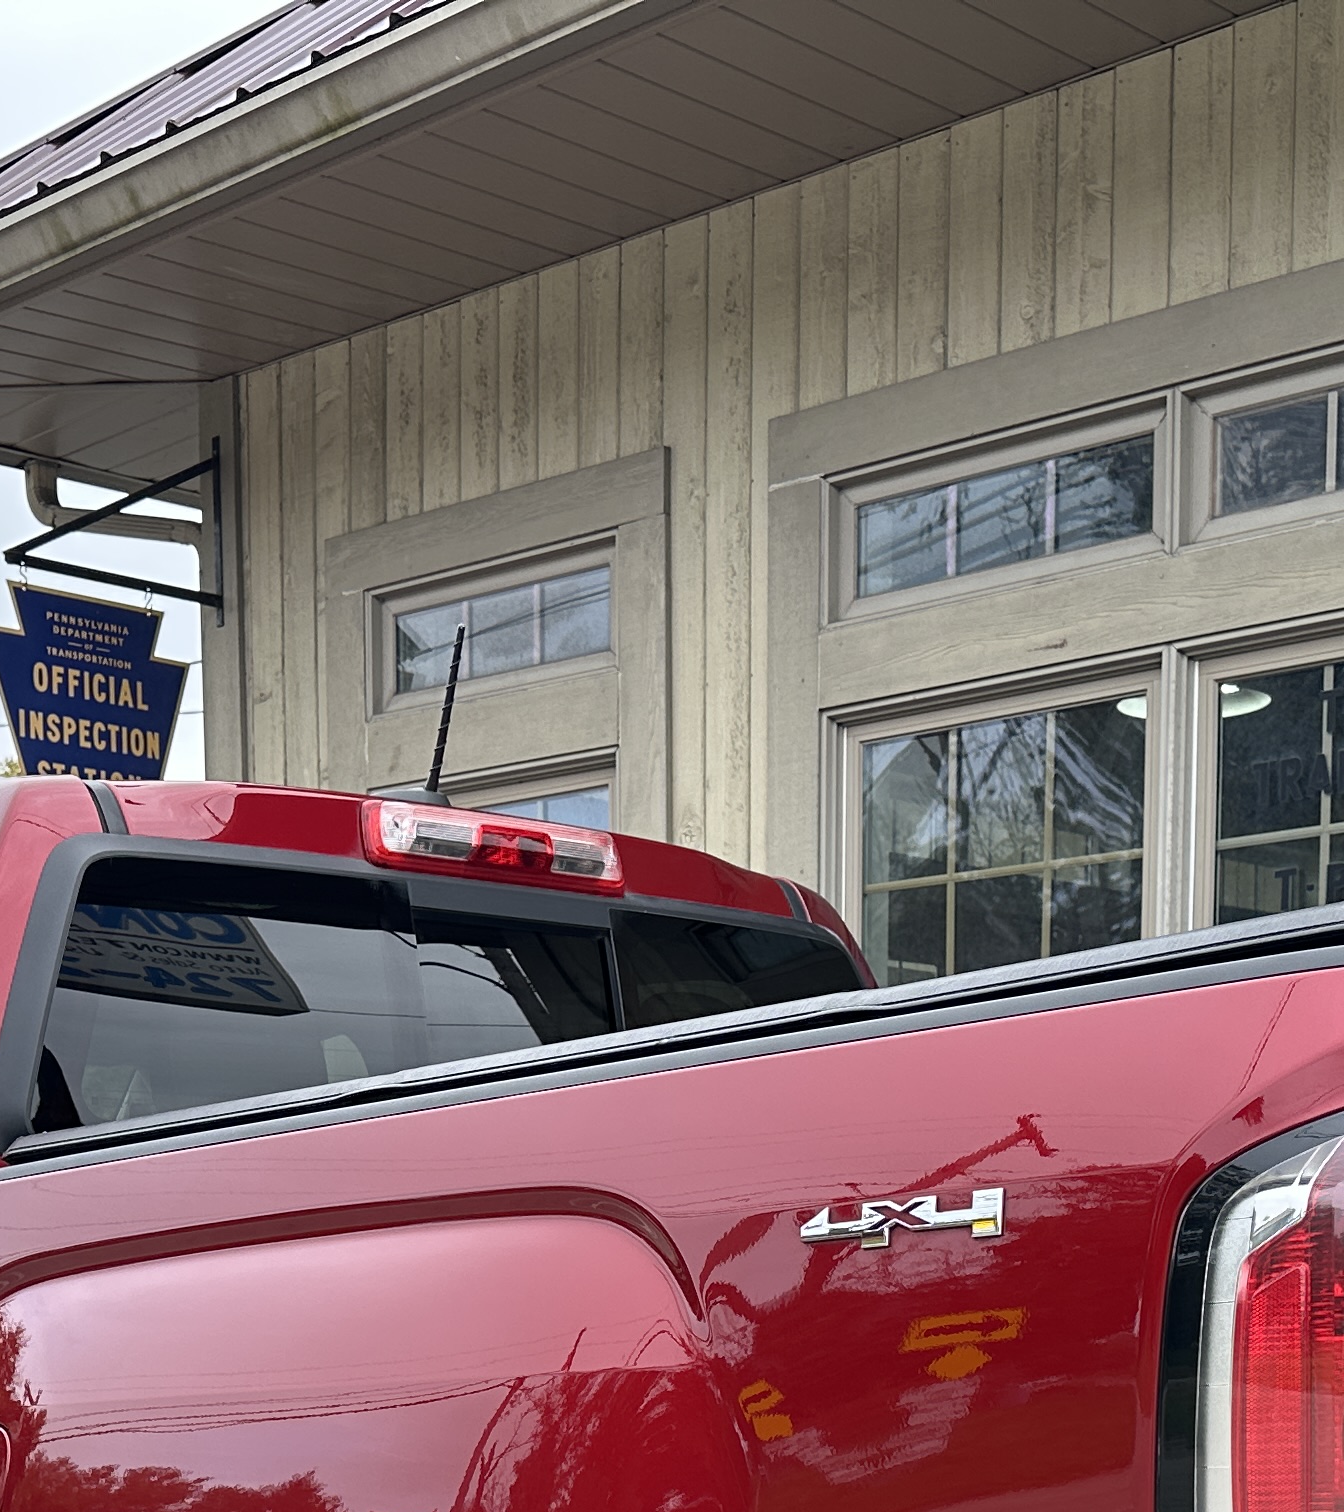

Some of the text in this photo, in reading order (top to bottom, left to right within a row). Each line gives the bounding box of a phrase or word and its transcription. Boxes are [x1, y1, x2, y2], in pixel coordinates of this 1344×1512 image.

[46, 610, 130, 636] PENNSYLVANIA
[52, 626, 125, 647] DEPARTMENT
[46, 646, 132, 671] TRANSPORTATION
[32, 661, 150, 711] OFFICIAL
[17, 708, 160, 760] INSPECTION
